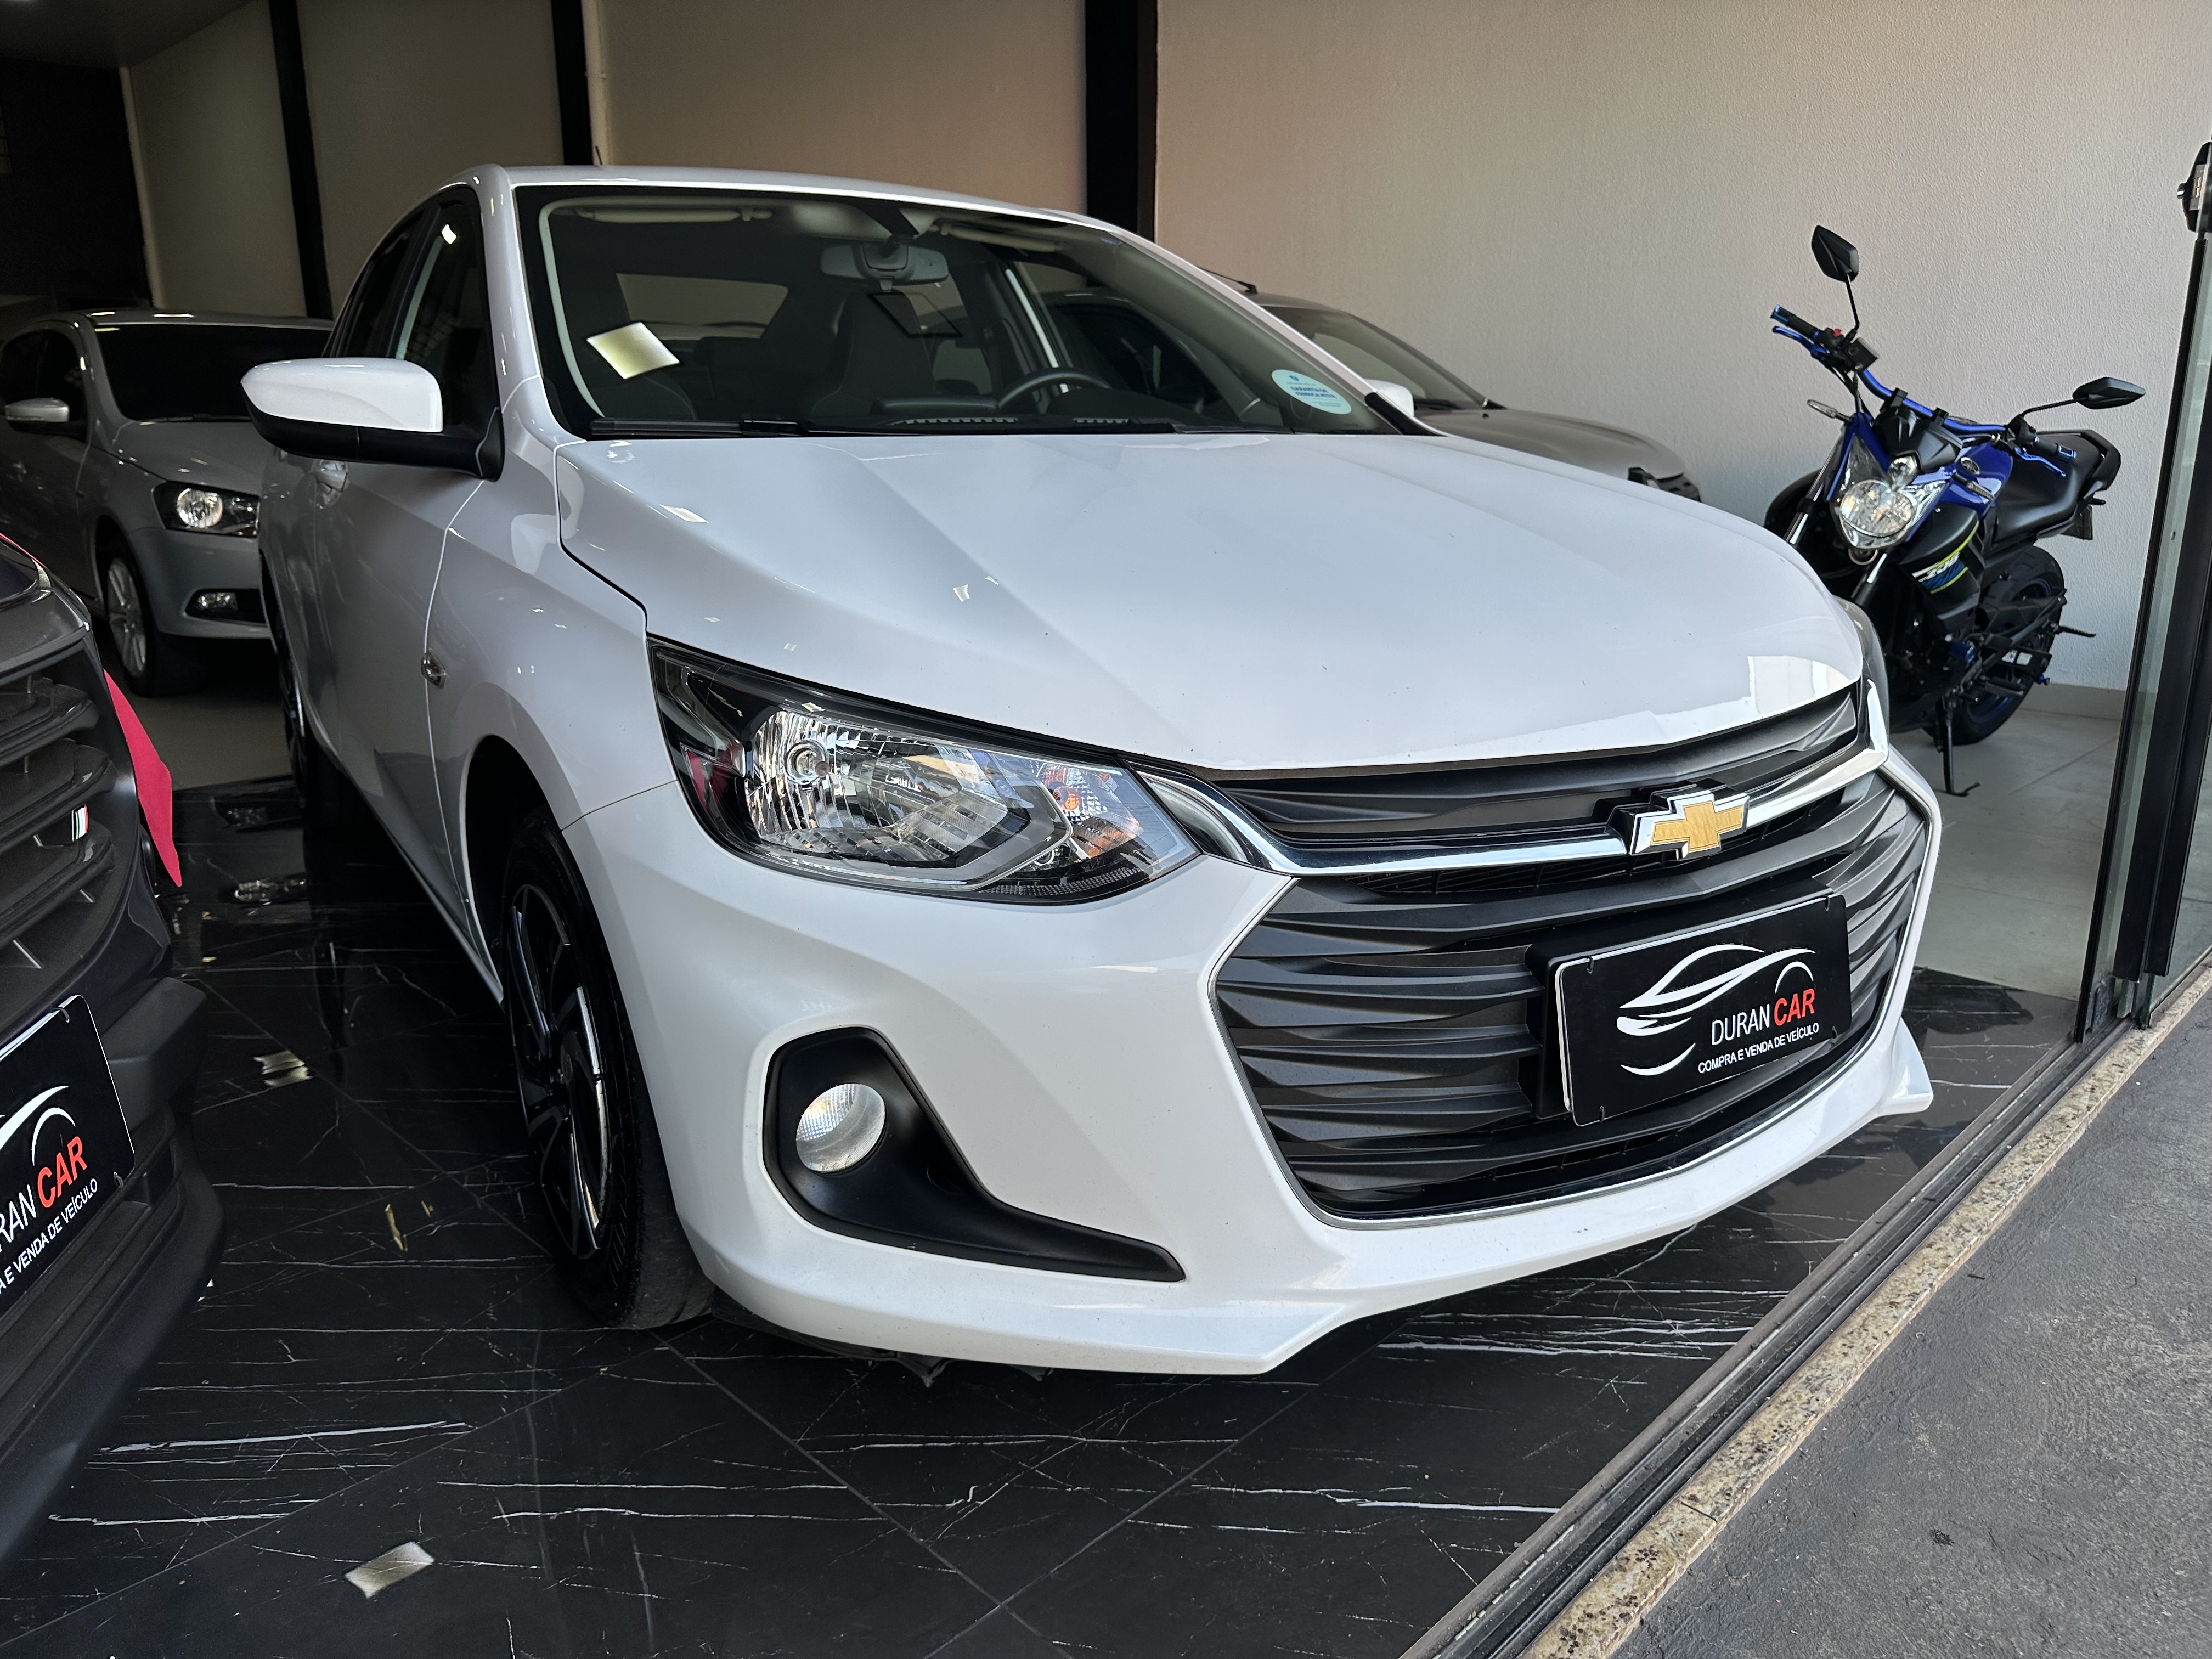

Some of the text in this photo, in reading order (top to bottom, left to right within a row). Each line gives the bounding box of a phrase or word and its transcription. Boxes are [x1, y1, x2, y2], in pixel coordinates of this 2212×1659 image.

[1698, 1022, 1820, 1074] COMPRA E VENDA DE VEÍCULO
[1712, 988, 1815, 1046] DURAN CAR
[37, 1136, 88, 1208] CAR
[4, 1178, 98, 1285] E VENDA DE VEÍCULO
